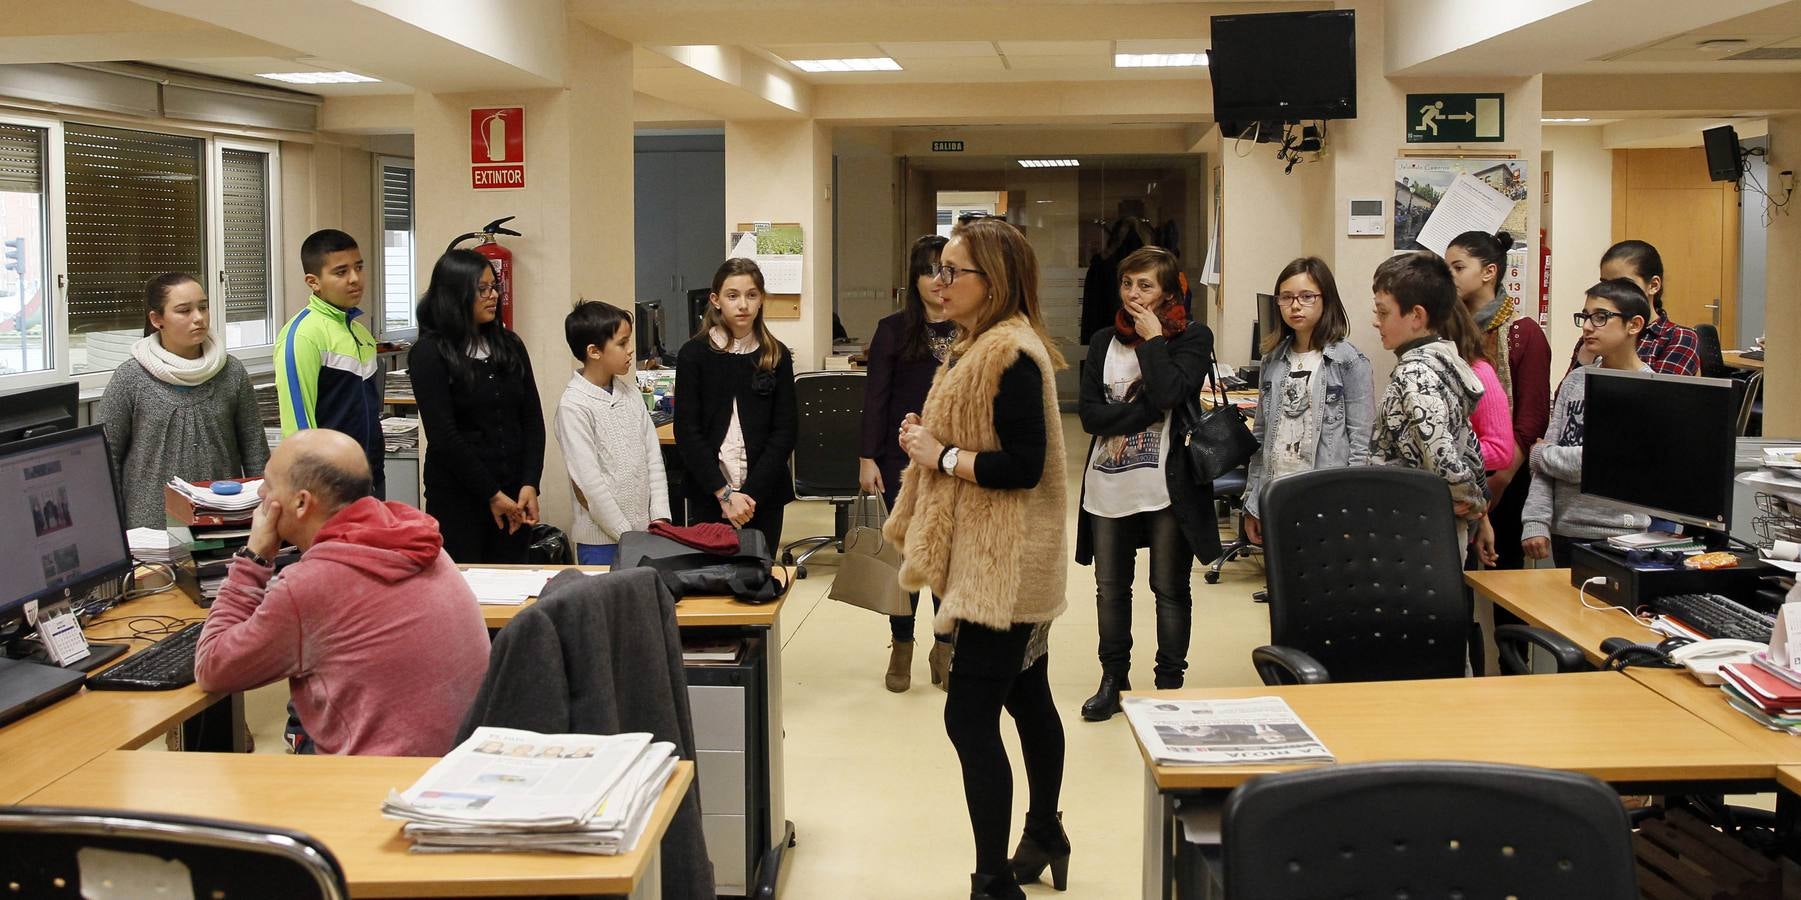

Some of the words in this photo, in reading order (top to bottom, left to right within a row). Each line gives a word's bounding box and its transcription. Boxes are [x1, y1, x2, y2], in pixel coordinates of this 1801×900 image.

[934, 142, 962, 151] SALIDA
[474, 169, 523, 185] EXTINTOR
[1511, 268, 1518, 277] 6
[1508, 282, 1521, 292] 13
[1225, 749, 1291, 758] RIOJA
